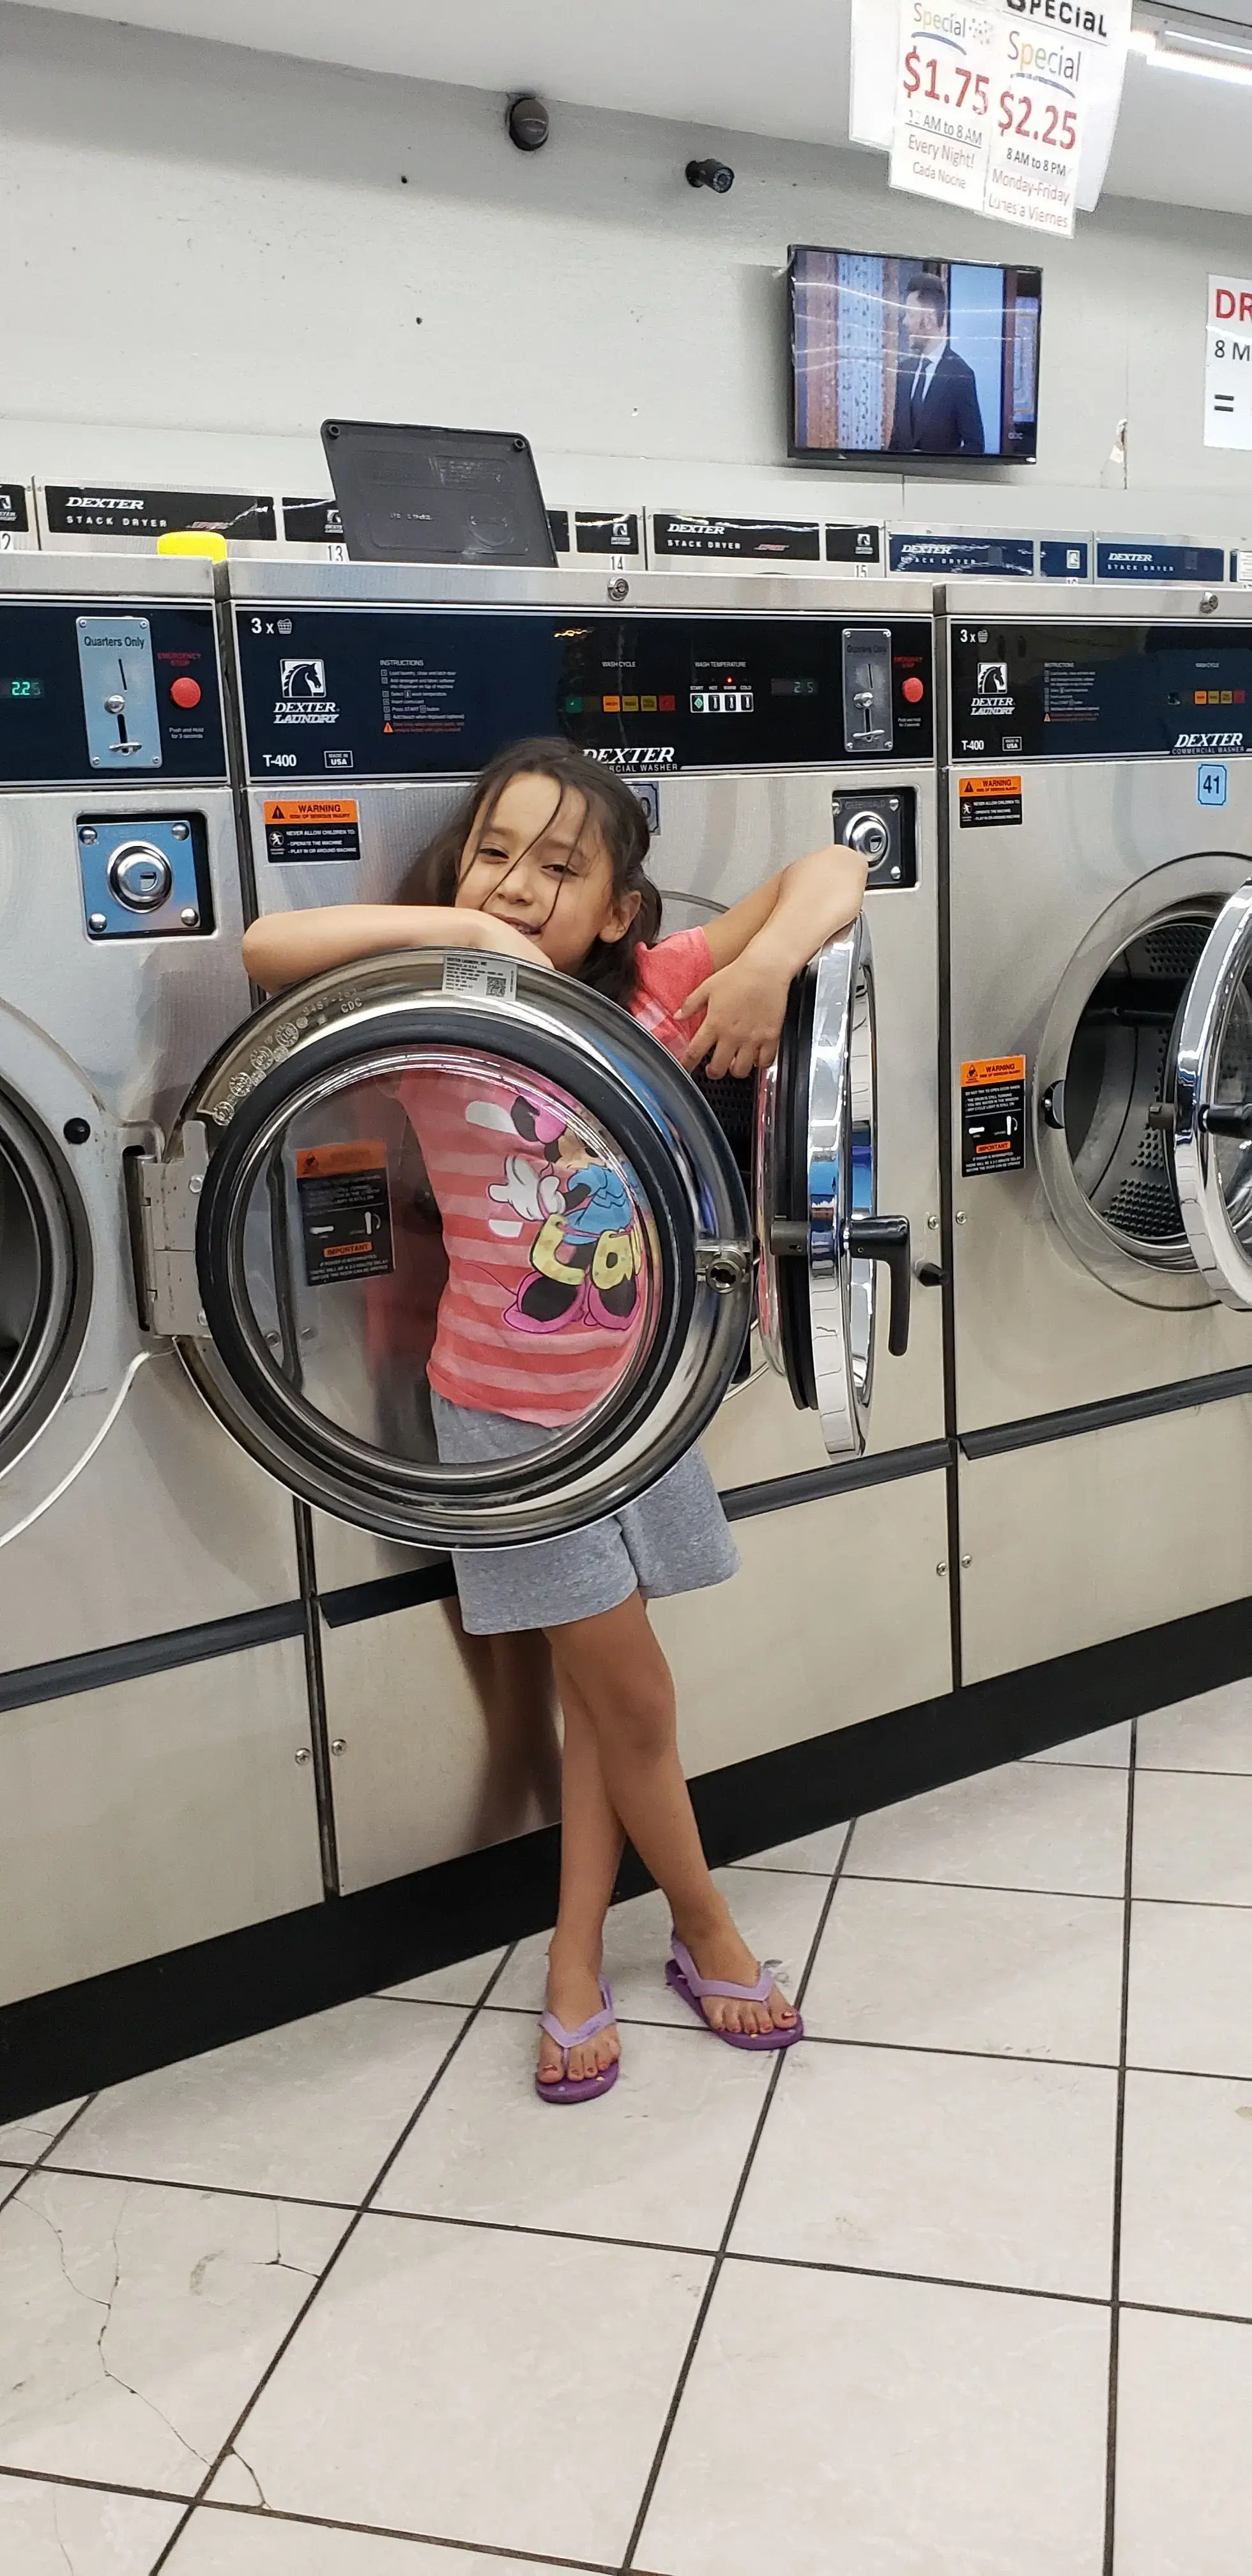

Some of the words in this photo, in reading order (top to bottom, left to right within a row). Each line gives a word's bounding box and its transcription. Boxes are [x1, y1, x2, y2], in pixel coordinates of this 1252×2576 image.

[913, 3, 966, 38] Special
[1007, 31, 1081, 82] Special
[903, 45, 989, 116] $1.75
[998, 88, 1078, 150] $2.25
[924, 114, 942, 132] AM
[944, 121, 955, 137] to
[956, 125, 963, 138] 8
[965, 128, 982, 145] AM
[908, 134, 938, 160] Every
[942, 144, 975, 169] Night!
[1006, 148, 1012, 160] 8
[1014, 151, 1029, 167] AM
[1032, 157, 1041, 170] to
[1043, 160, 1049, 171] 8
[1051, 162, 1066, 177] PM
[913, 162, 936, 180] Cada
[938, 169, 966, 189] Noche
[992, 168, 1070, 206] Monday-Friday
[1019, 204, 1025, 217] a
[1028, 206, 1067, 228] Viernes
[1214, 340, 1225, 358] 8
[65, 496, 144, 510] DEXTER
[66, 516, 114, 526] STACK
[122, 518, 167, 527] DRYER
[667, 523, 725, 534] DEXTER
[328, 546, 343, 562] 13
[901, 544, 952, 555] DEXTER
[611, 556, 623, 570] 14
[1108, 553, 1153, 562] DEXTER
[857, 564, 867, 578] 15
[251, 618, 262, 634] 3
[266, 623, 274, 634] x
[84, 636, 122, 647] Quarters
[125, 636, 145, 650] Only
[960, 630, 968, 642] 3
[970, 633, 976, 642] x
[273, 702, 337, 712] DEXTER
[971, 698, 1014, 706] DEXTER
[970, 707, 1016, 716] LAUNDRY
[273, 714, 340, 724] LAUNDRY
[961, 740, 984, 751] T-400
[1174, 733, 1243, 747] DEXTER
[263, 755, 296, 767] T-400
[583, 747, 675, 764] DEXTER
[640, 763, 678, 772] WASHER
[1203, 774, 1219, 794] 41
[298, 804, 340, 813] WARNING
[341, 998, 362, 1013] CDC
[986, 1064, 1014, 1072] WARNING
[979, 1143, 1008, 1151] IMPORTANT
[328, 1245, 369, 1255] IMPORTANT
